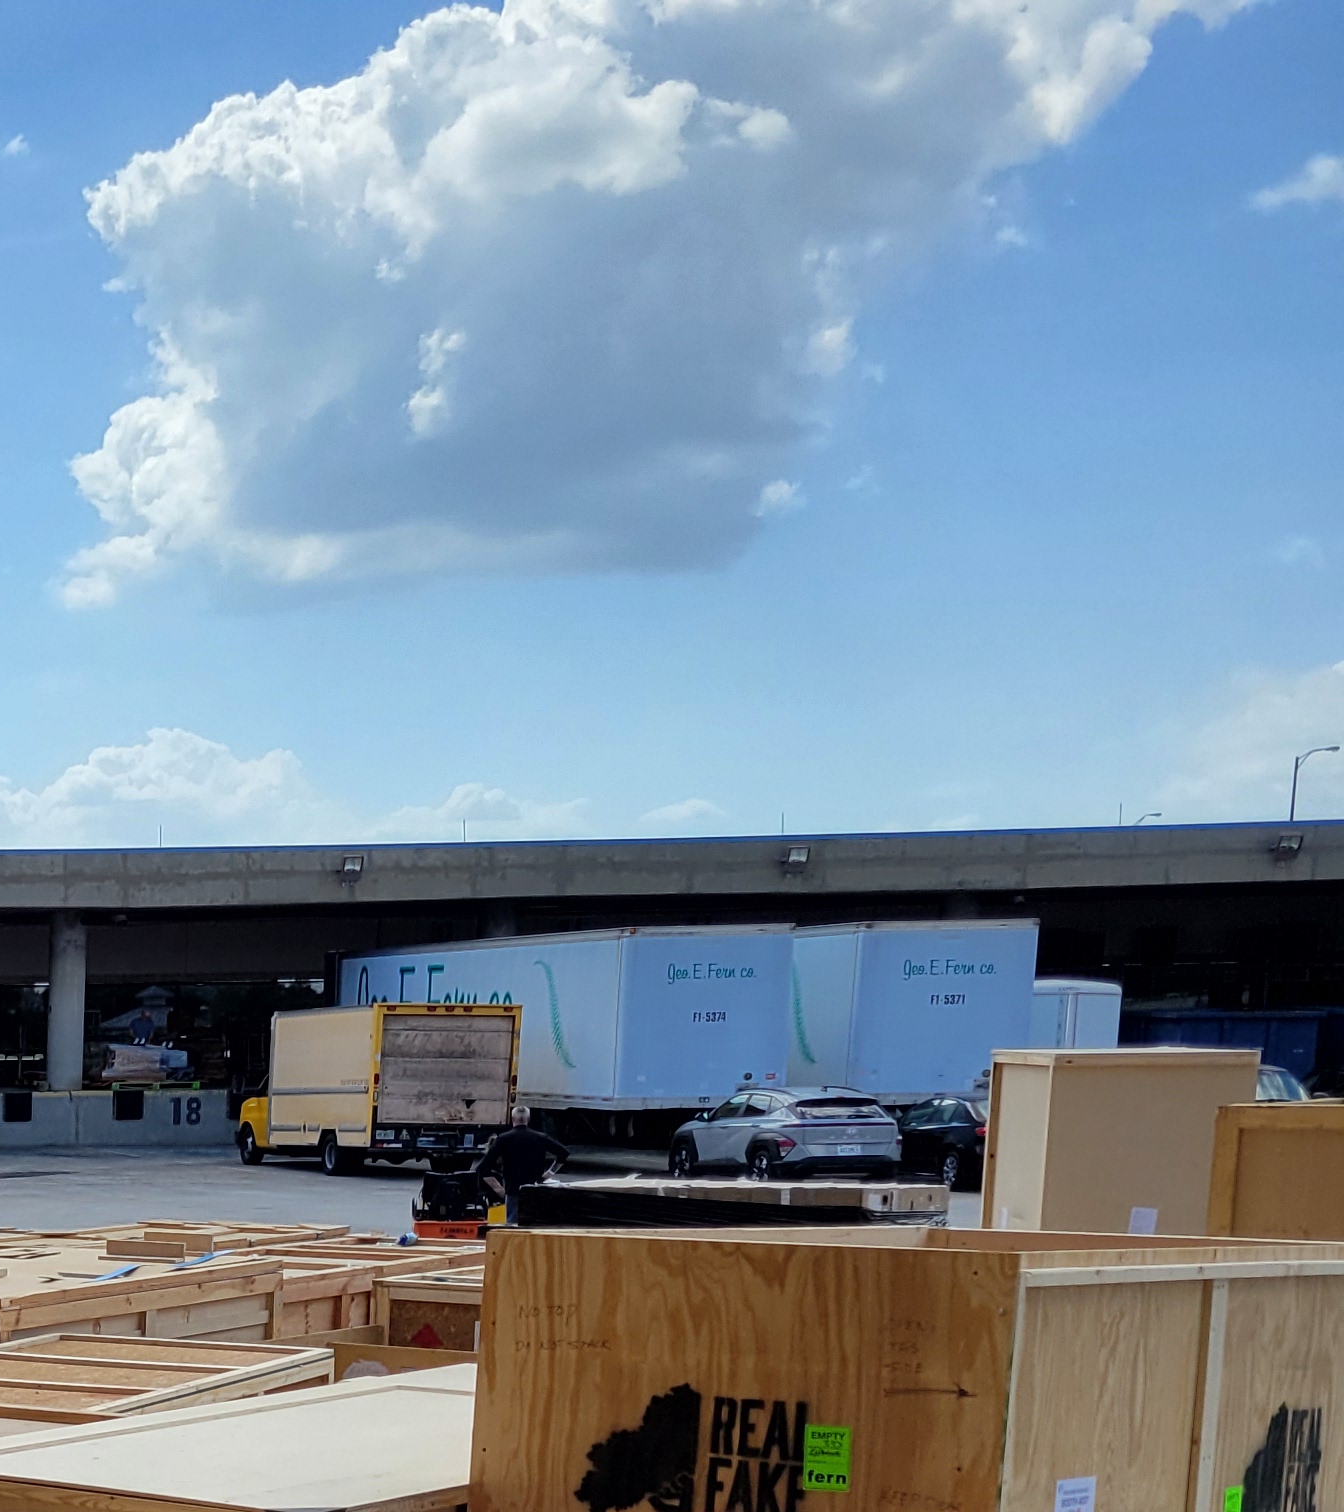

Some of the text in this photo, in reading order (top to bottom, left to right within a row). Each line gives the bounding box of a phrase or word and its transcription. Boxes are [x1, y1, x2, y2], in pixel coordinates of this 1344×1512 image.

[707, 963, 736, 979] Fern
[945, 959, 975, 975] Fern
[930, 994, 967, 1005] F1-5371
[693, 1011, 727, 1023] F1-5374
[169, 1097, 202, 1125] 18
[709, 1396, 808, 1463] REAL
[811, 1431, 846, 1441] EMPTY
[807, 1469, 848, 1485] fern
